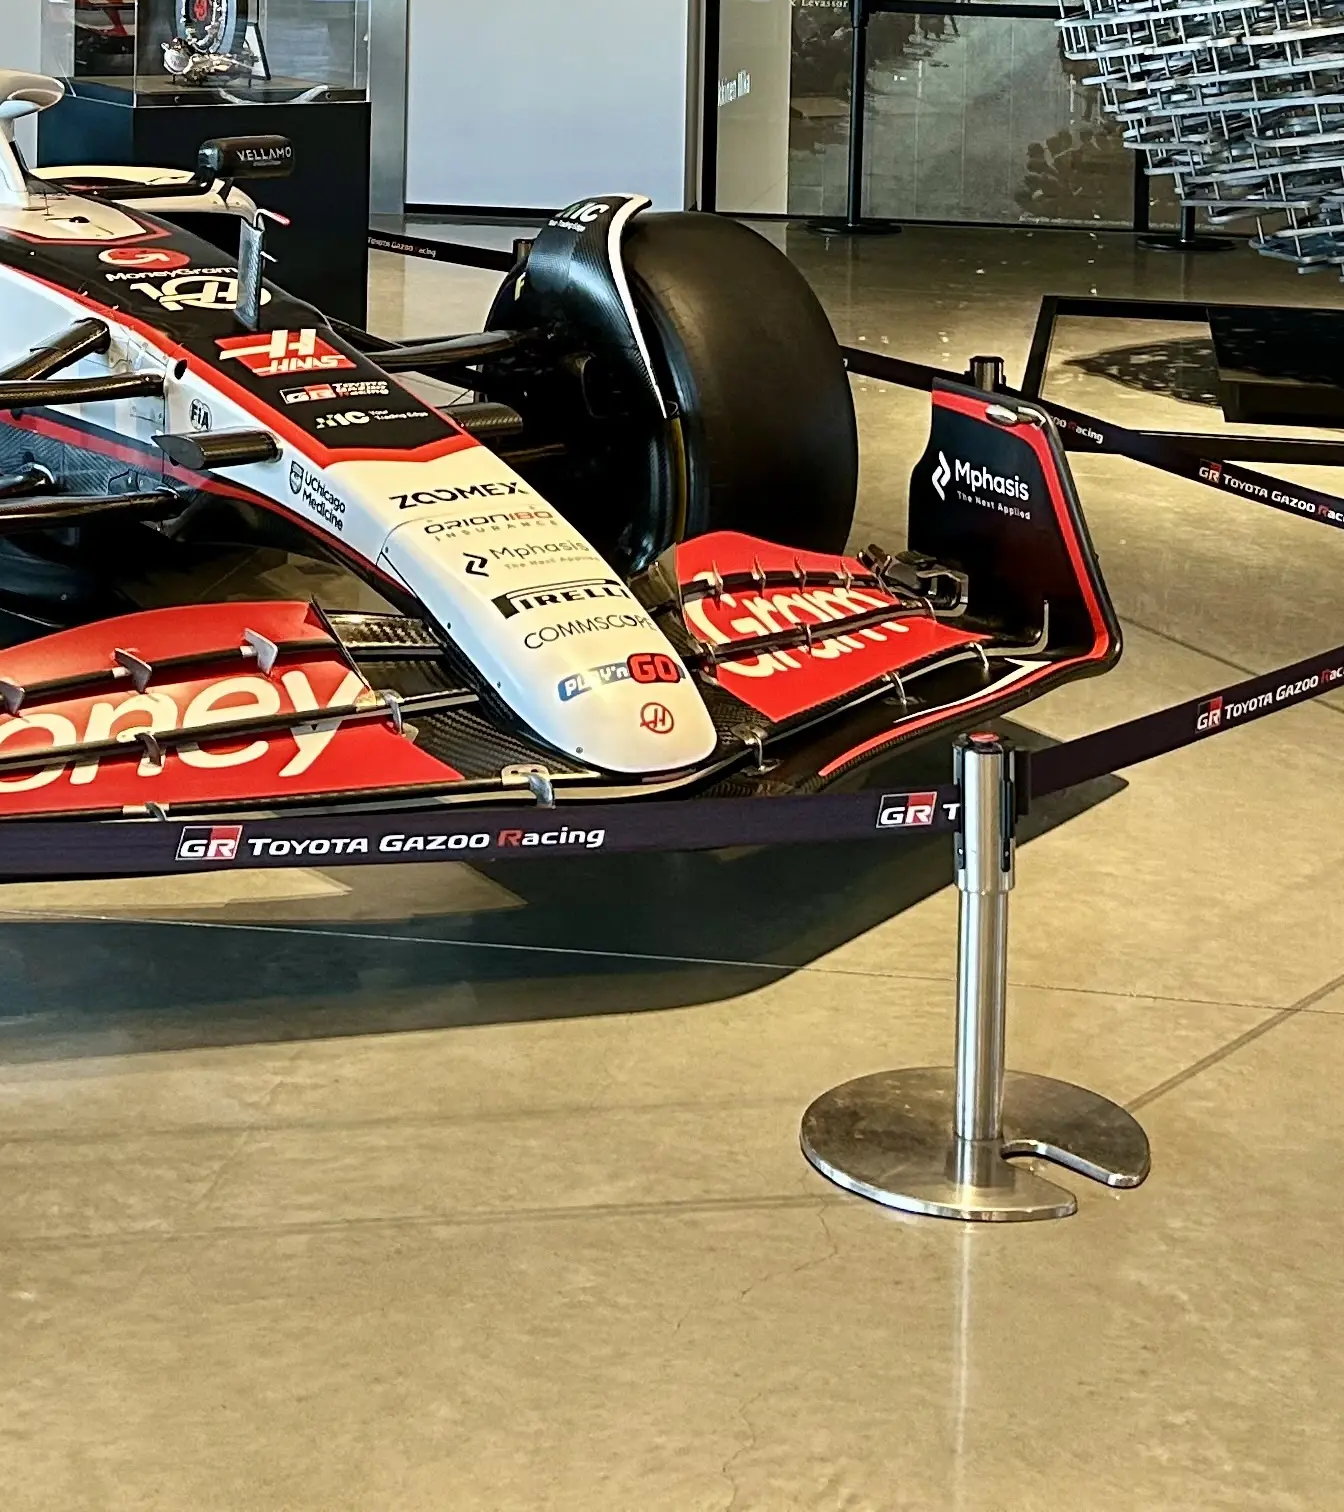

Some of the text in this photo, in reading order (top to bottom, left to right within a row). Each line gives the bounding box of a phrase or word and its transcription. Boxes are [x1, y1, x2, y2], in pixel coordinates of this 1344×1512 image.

[236, 146, 292, 161] VELLAMO
[190, 404, 211, 431] FIA
[1068, 421, 1104, 444] Racing
[305, 471, 346, 514] UChicago
[955, 459, 1030, 501] Mphasis
[1198, 464, 1222, 484] GR
[1223, 473, 1269, 499] TOYOTA
[1271, 490, 1317, 513] GAZOO
[388, 481, 529, 510] ZOOMEX
[957, 490, 973, 503] The
[997, 502, 1031, 520] Applied
[302, 491, 344, 531] Medicine
[434, 520, 559, 542] INSURANCE
[488, 540, 590, 561] Mphasis
[490, 577, 632, 620] PIRELLI
[524, 613, 658, 649] COMMSCOPE
[629, 653, 681, 683] GO
[1196, 705, 1223, 732] GR
[1224, 692, 1273, 720] TOYOTA
[1275, 674, 1319, 701] GAZOO
[878, 798, 935, 827] GR
[177, 826, 605, 860] GR TOYOTA GAZOO Racing
